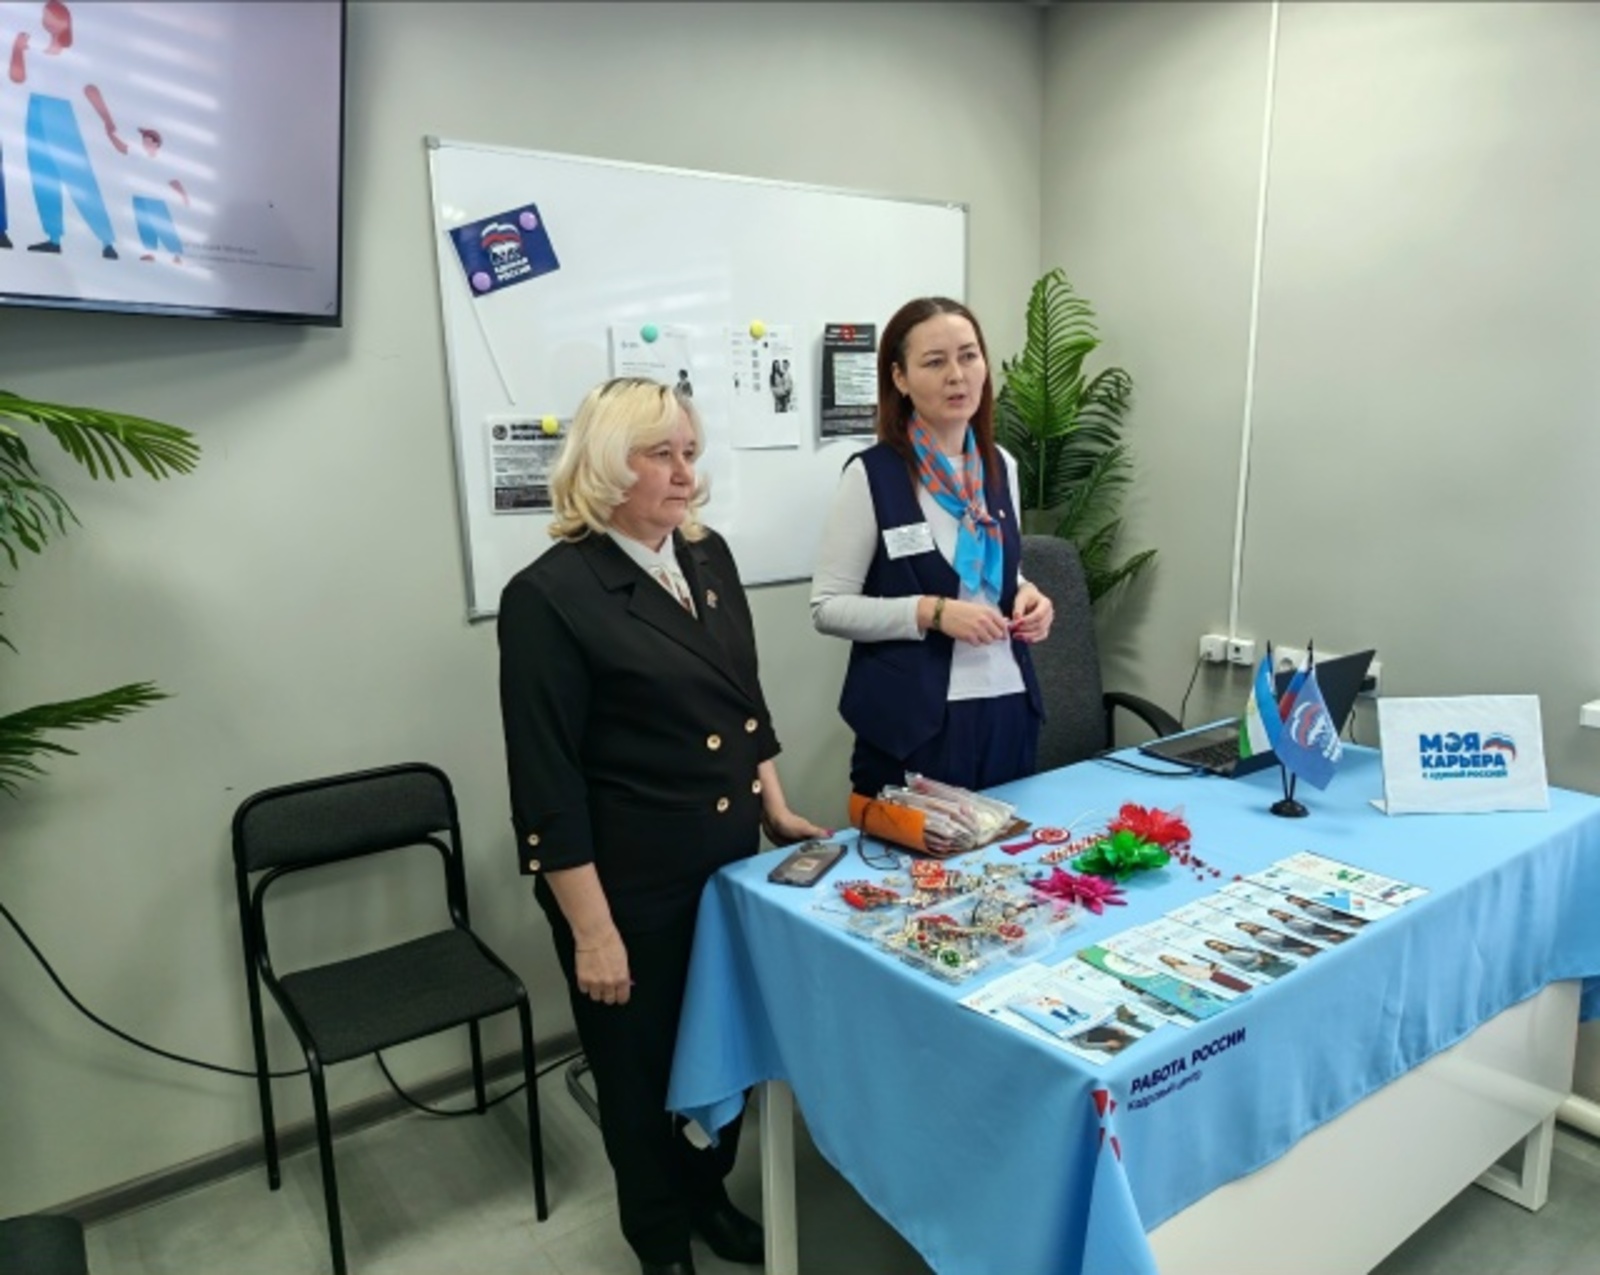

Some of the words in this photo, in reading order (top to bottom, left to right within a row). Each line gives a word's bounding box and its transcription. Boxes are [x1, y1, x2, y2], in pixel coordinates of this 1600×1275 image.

[1421, 754, 1505, 769] КАРЬЕРА
[1130, 1057, 1187, 1095] РАБОТА
[1191, 1027, 1246, 1065] РОССИИ
